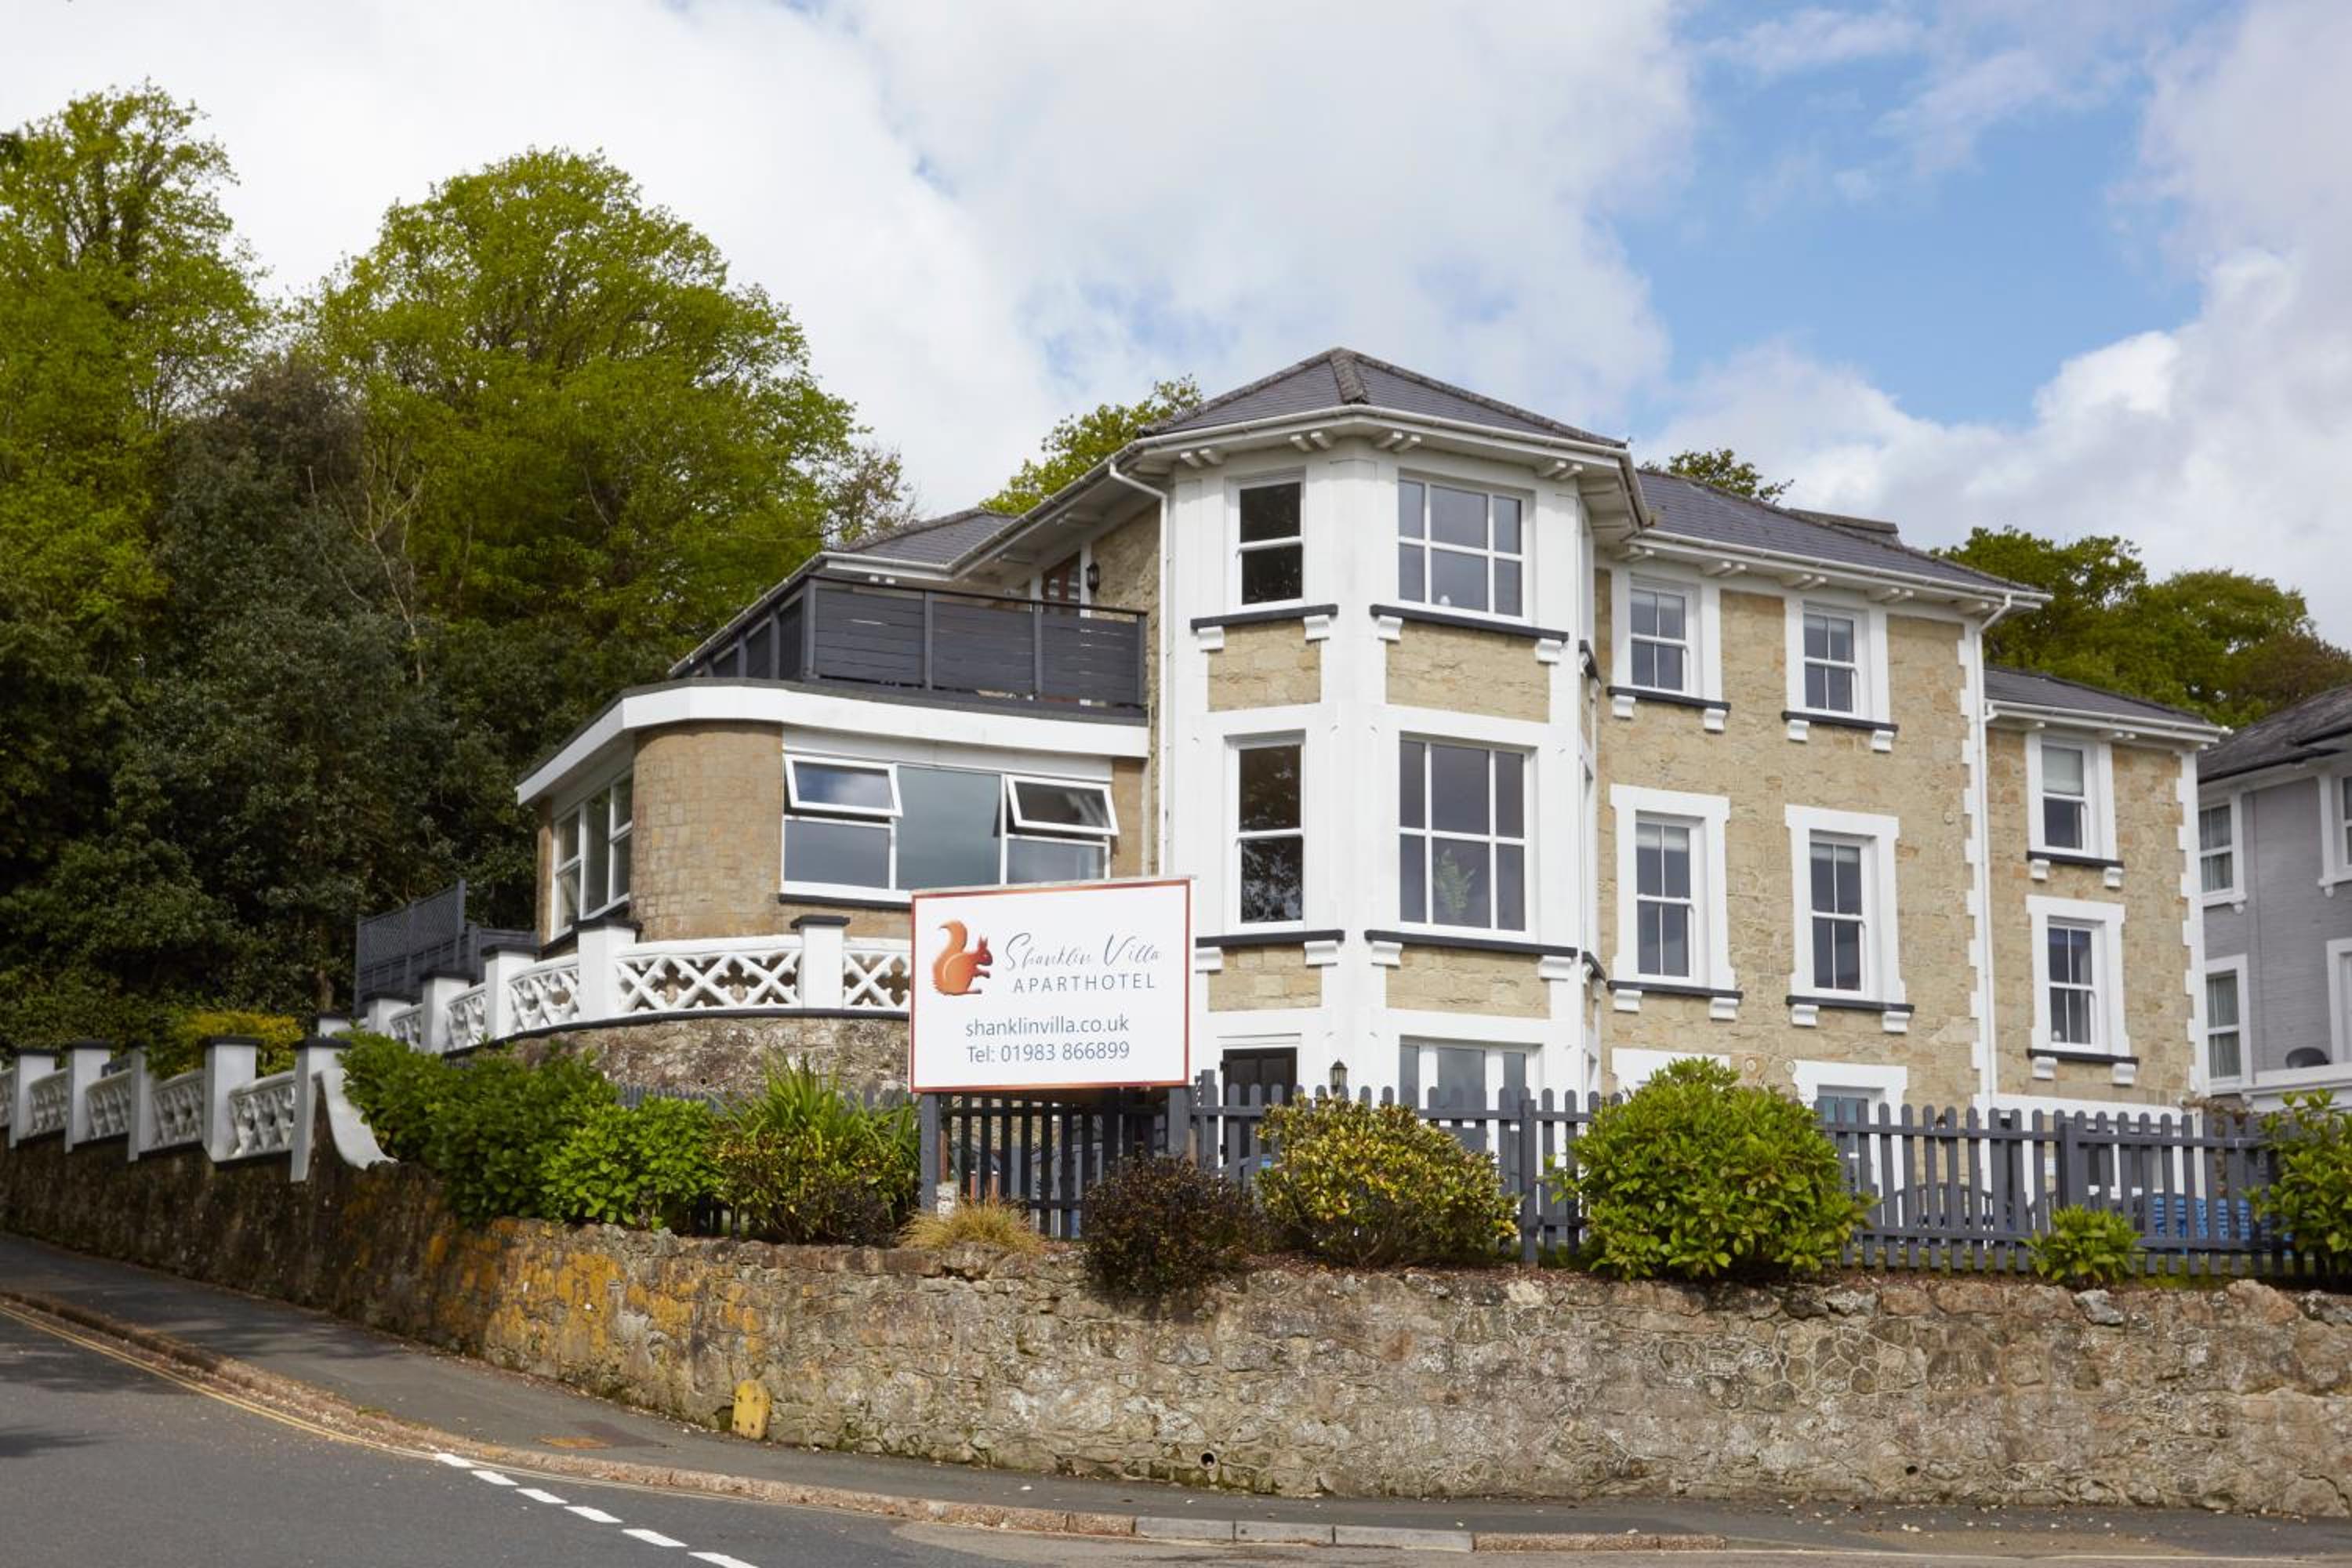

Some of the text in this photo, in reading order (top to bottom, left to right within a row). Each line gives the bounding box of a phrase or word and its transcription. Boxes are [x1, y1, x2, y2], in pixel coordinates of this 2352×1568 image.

[1004, 932, 1160, 971] Shanklin Villa
[1012, 972, 1156, 993] APARTHOTEL
[965, 1014, 1130, 1037] shanklinvilla.co.uk
[966, 1040, 1131, 1063] Tel: 01983 866899
